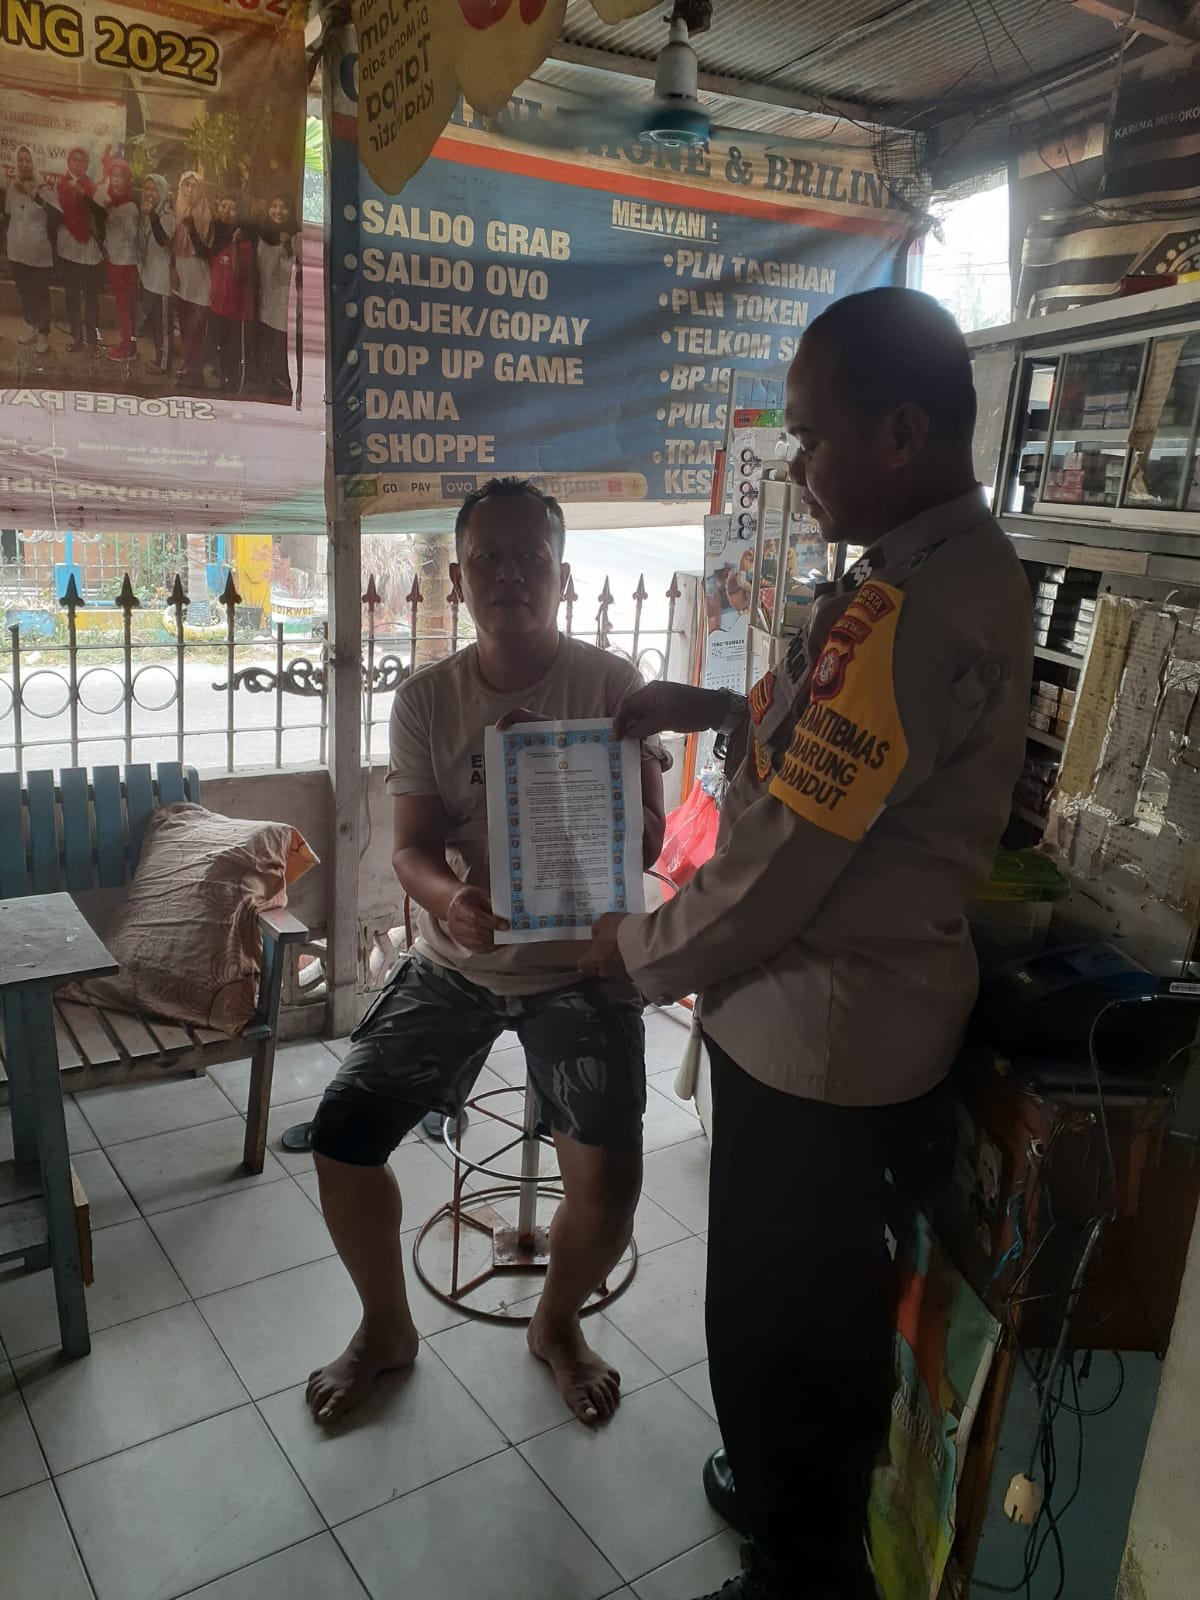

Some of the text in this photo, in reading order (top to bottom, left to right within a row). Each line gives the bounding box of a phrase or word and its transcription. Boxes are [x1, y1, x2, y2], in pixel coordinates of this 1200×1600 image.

[0, 0, 220, 87] NG 2022
[725, 146, 752, 184] &
[362, 199, 571, 262] SALDO GRAB
[612, 199, 706, 238] MELAYANI
[362, 248, 549, 301] SALDO OVO
[676, 248, 837, 295] PLN TAGIHAN
[363, 295, 591, 346] GOJEK/GOPAY
[671, 288, 810, 327] PLN TOKEN
[674, 326, 772, 360] TELKOM
[362, 343, 585, 386] TOP UP GAME
[671, 364, 731, 394] BPJS
[365, 388, 461, 422] DANA
[668, 402, 728, 430] PULS
[366, 433, 496, 464] SHOPPE
[383, 482, 397, 494] GO
[411, 482, 431, 494] PAY
[446, 482, 473, 493] OVO
